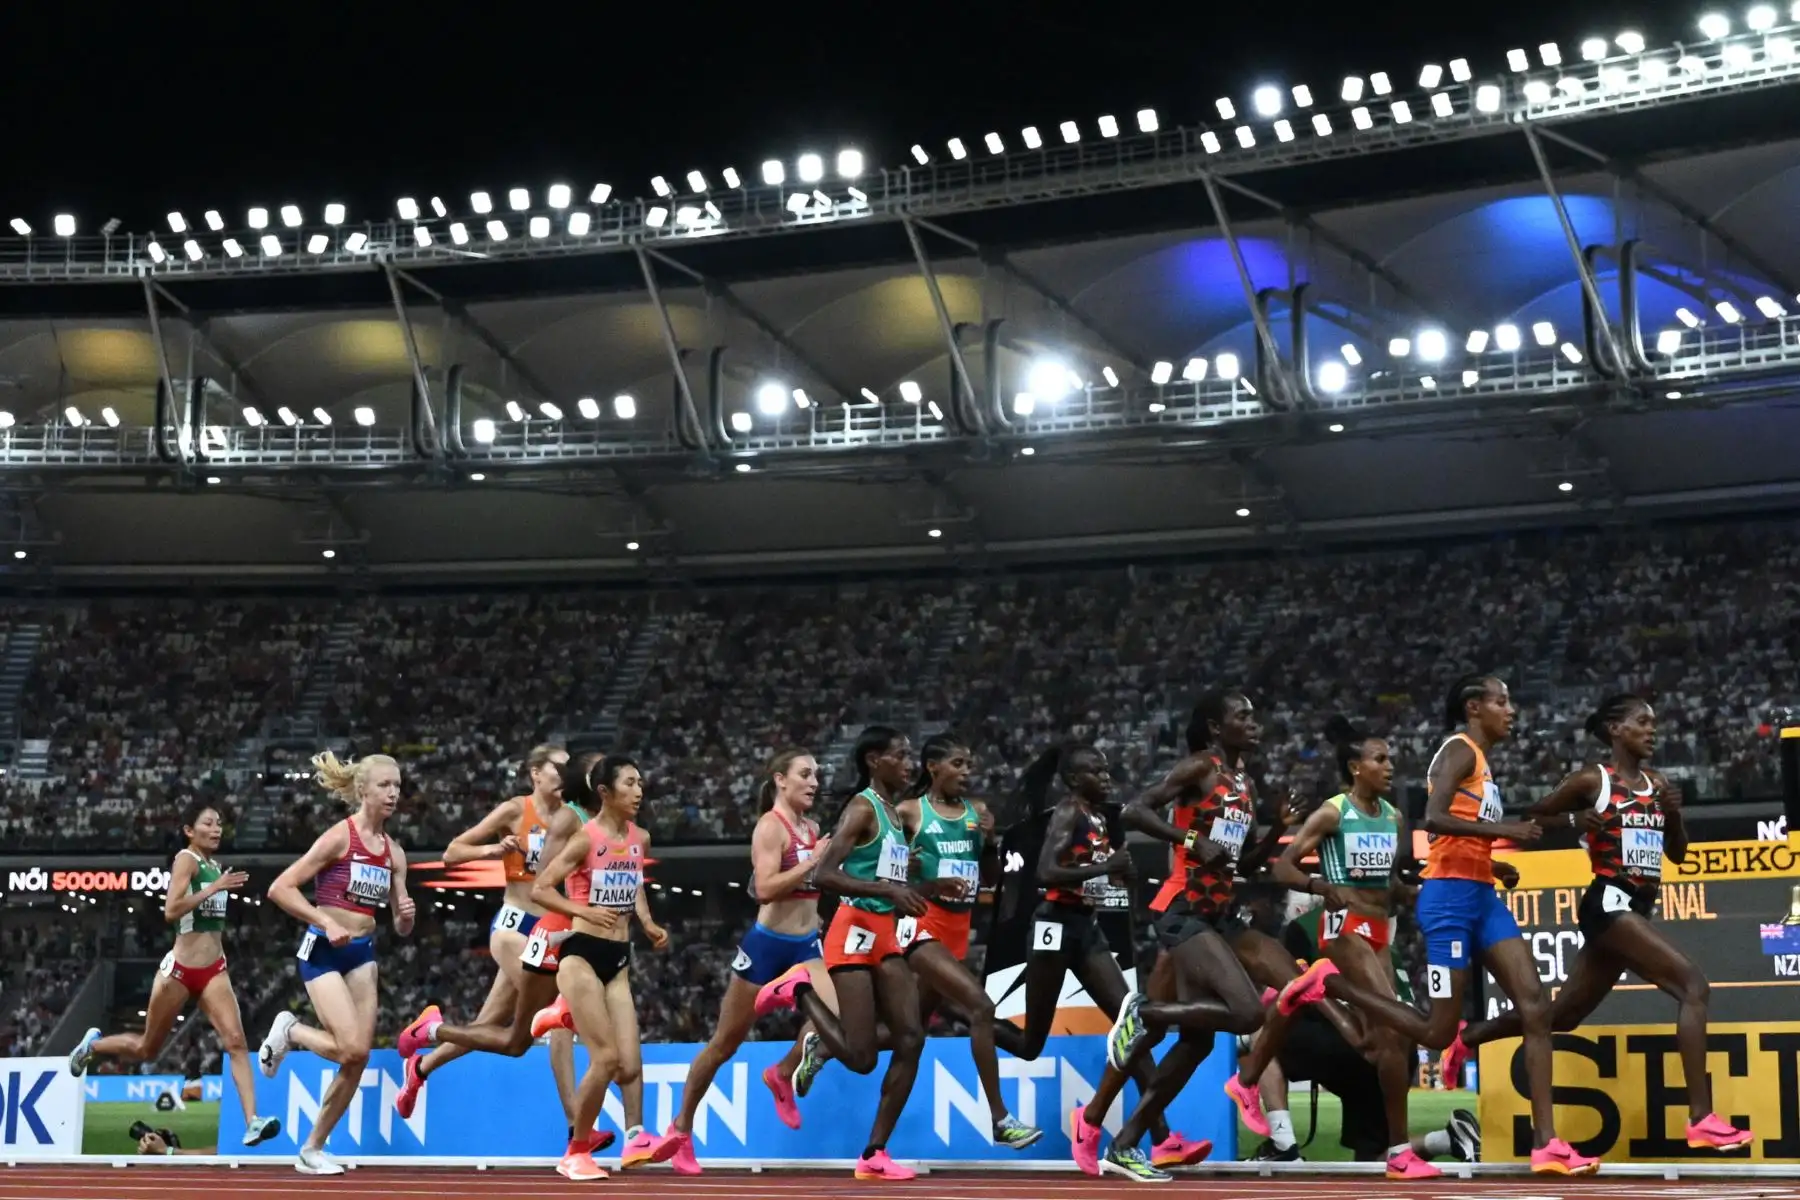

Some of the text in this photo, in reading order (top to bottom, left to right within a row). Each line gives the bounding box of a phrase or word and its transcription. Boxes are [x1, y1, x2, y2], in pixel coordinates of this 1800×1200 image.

[1357, 834, 1392, 849] NTN
[604, 861, 637, 870] JAPAN
[1351, 852, 1395, 867] TSEGA
[1627, 848, 1661, 866] KIPYEG
[52, 871, 128, 891] 5000M
[361, 864, 388, 883] NTN
[604, 872, 638, 886] NTN
[502, 910, 518, 929] 15
[855, 933, 867, 950] 7
[1042, 927, 1053, 945] 6
[531, 941, 540, 959] 9
[1431, 970, 1441, 992] 8
[0, 1071, 58, 1144] K
[286, 1068, 427, 1147] NTN
[934, 1056, 1123, 1147] NTN
